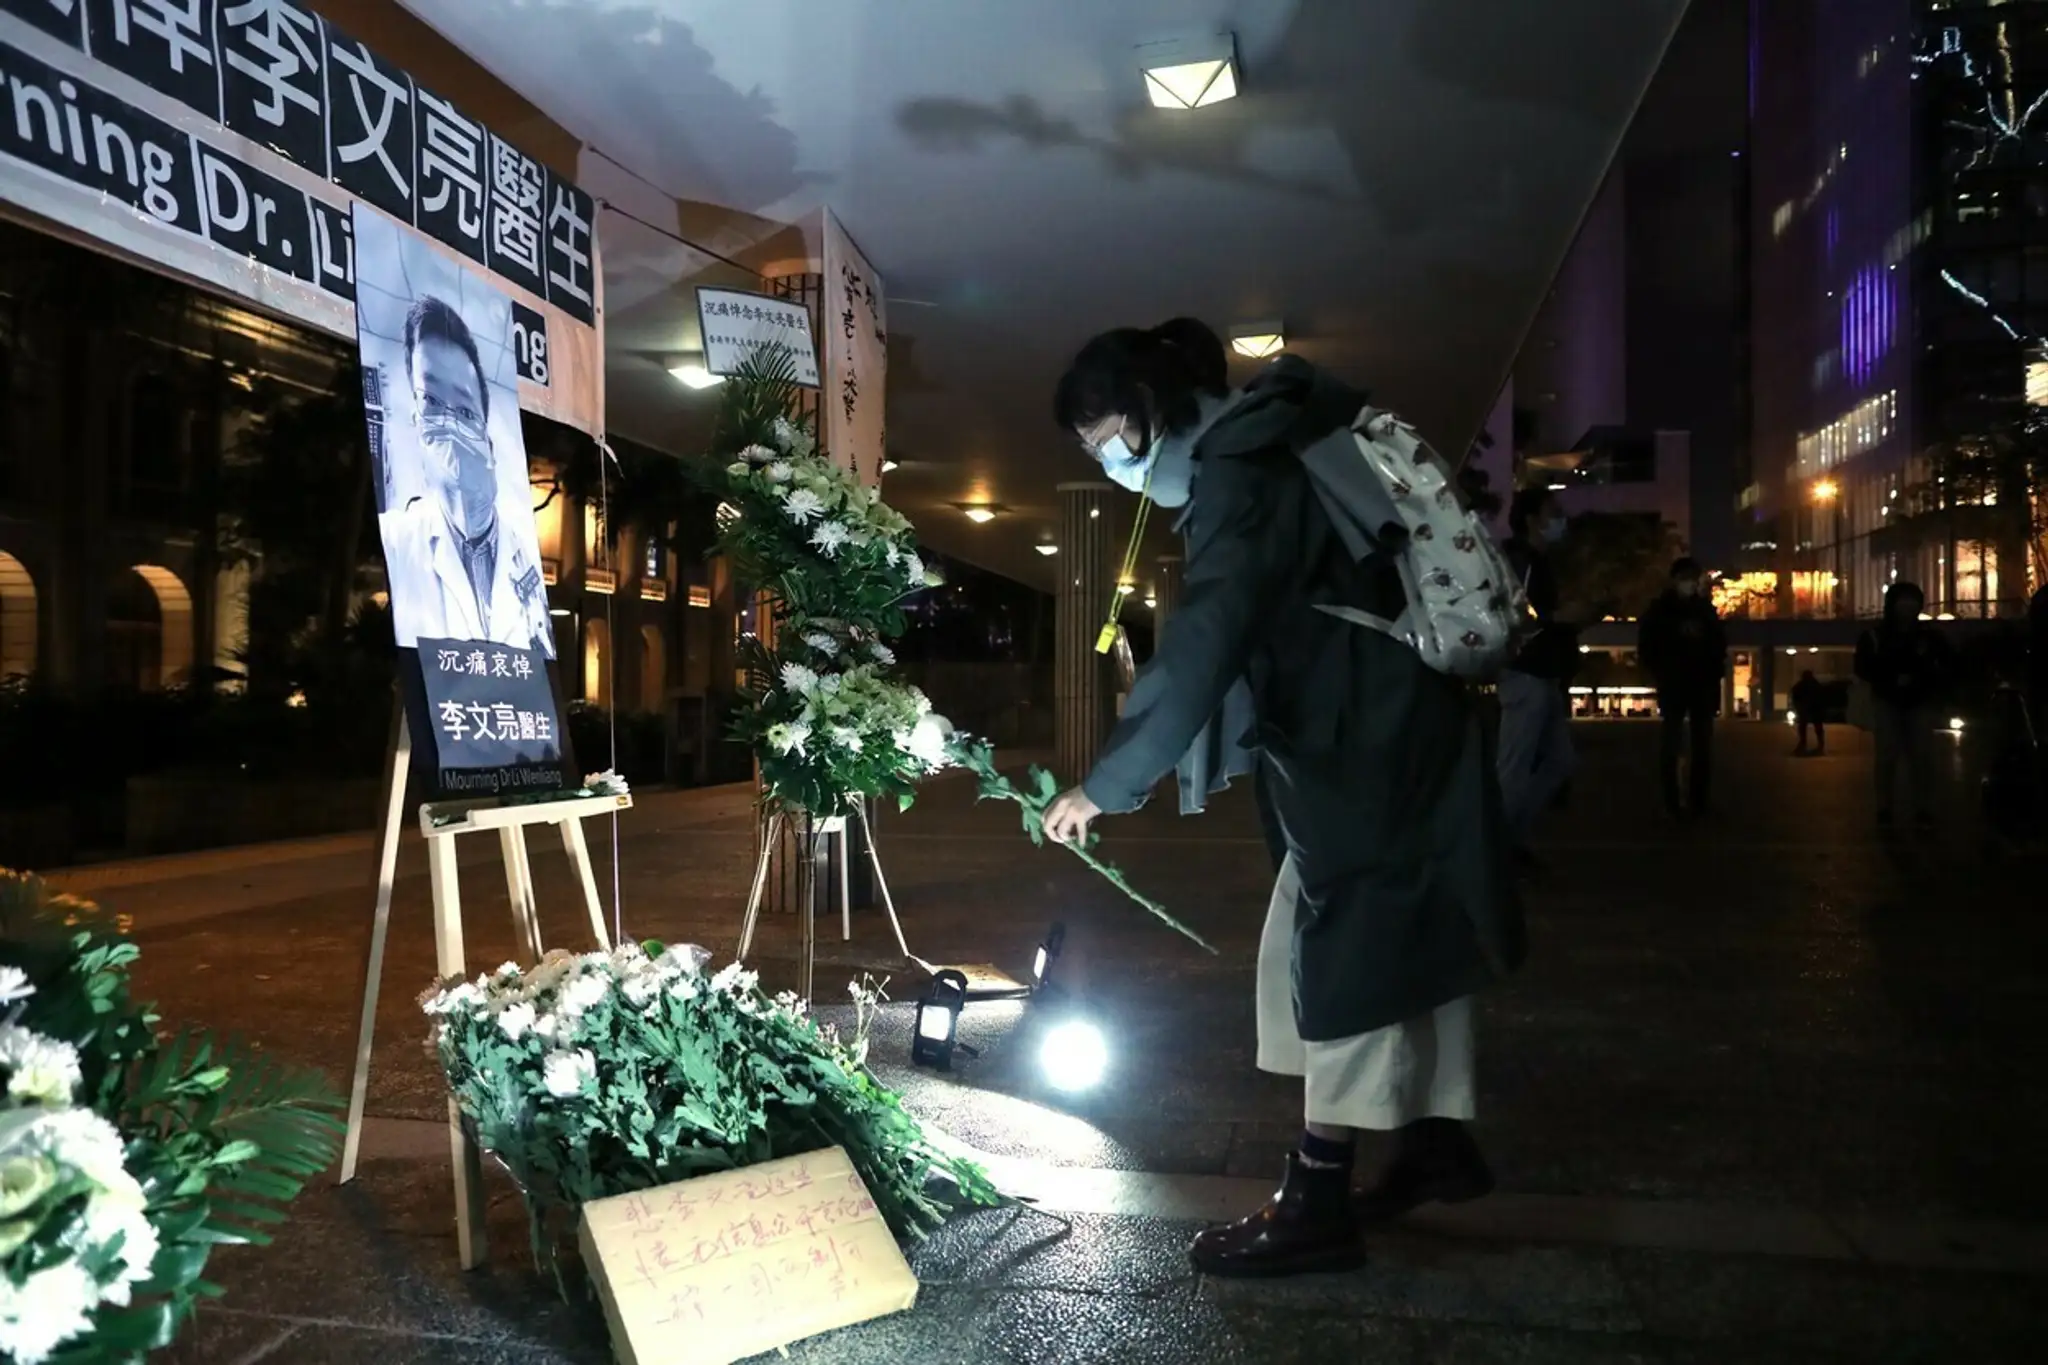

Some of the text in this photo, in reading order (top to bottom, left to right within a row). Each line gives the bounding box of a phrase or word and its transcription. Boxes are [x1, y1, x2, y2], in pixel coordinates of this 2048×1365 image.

[0, 69, 548, 383] ning Dr. Li ng
[437, 649, 533, 680] 沉痛哀悼
[438, 699, 552, 741] 李文亮醫生
[445, 767, 499, 793] Mourning
[519, 766, 563, 788] Wenliang
